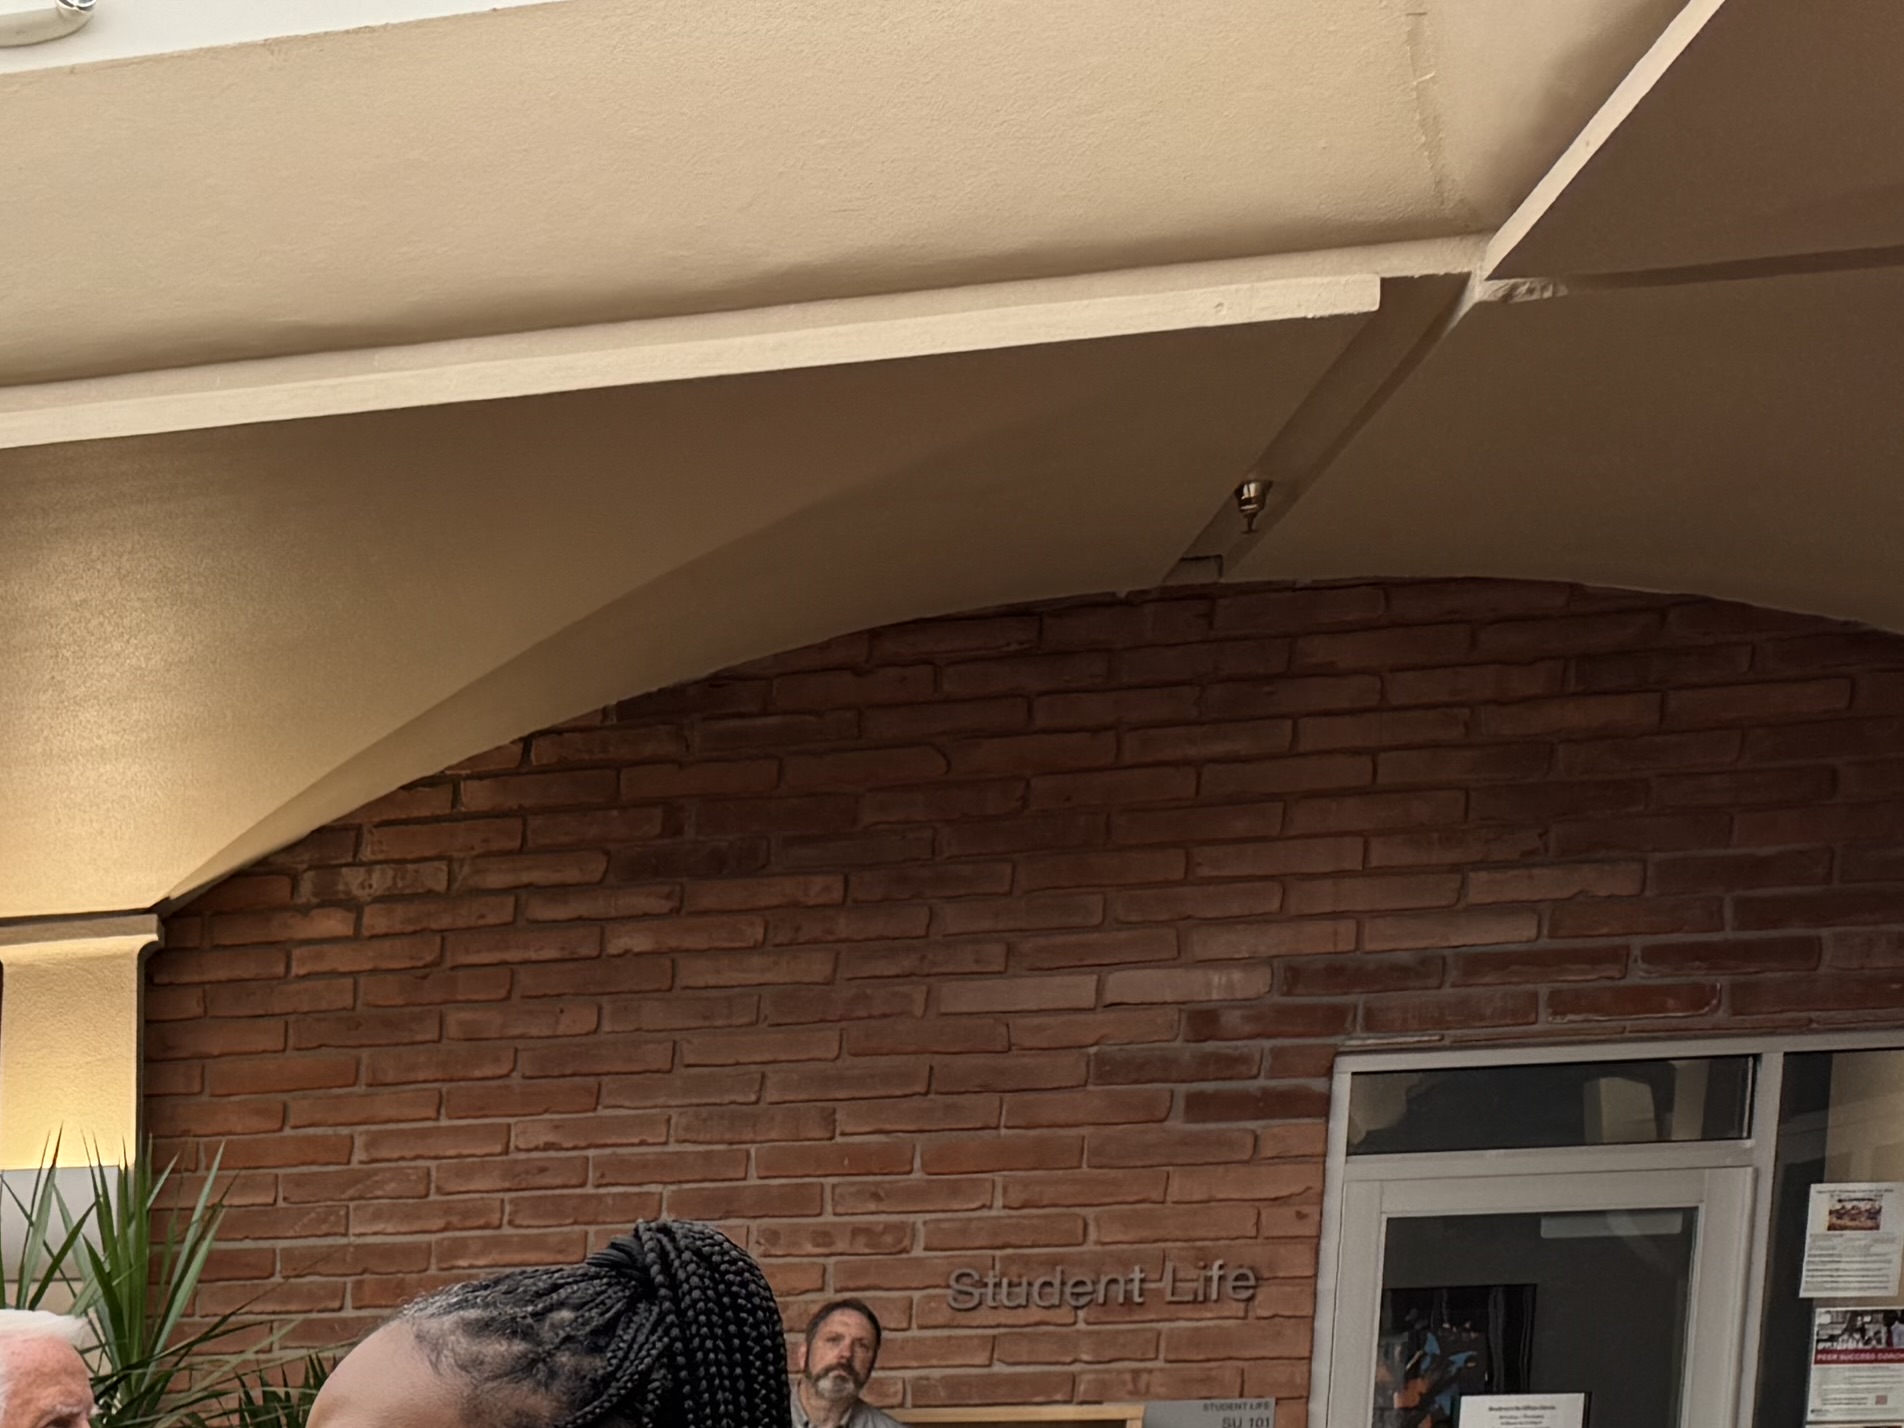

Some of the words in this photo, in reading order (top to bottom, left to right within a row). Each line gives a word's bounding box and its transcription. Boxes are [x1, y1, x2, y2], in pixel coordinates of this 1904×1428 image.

[946, 1264, 1146, 1311] Student
[1164, 1258, 1257, 1304] Life
[1202, 1402, 1249, 1412] STUDENT
[1249, 1401, 1271, 1411] LIFE
[1249, 1417, 1271, 1428] 101
